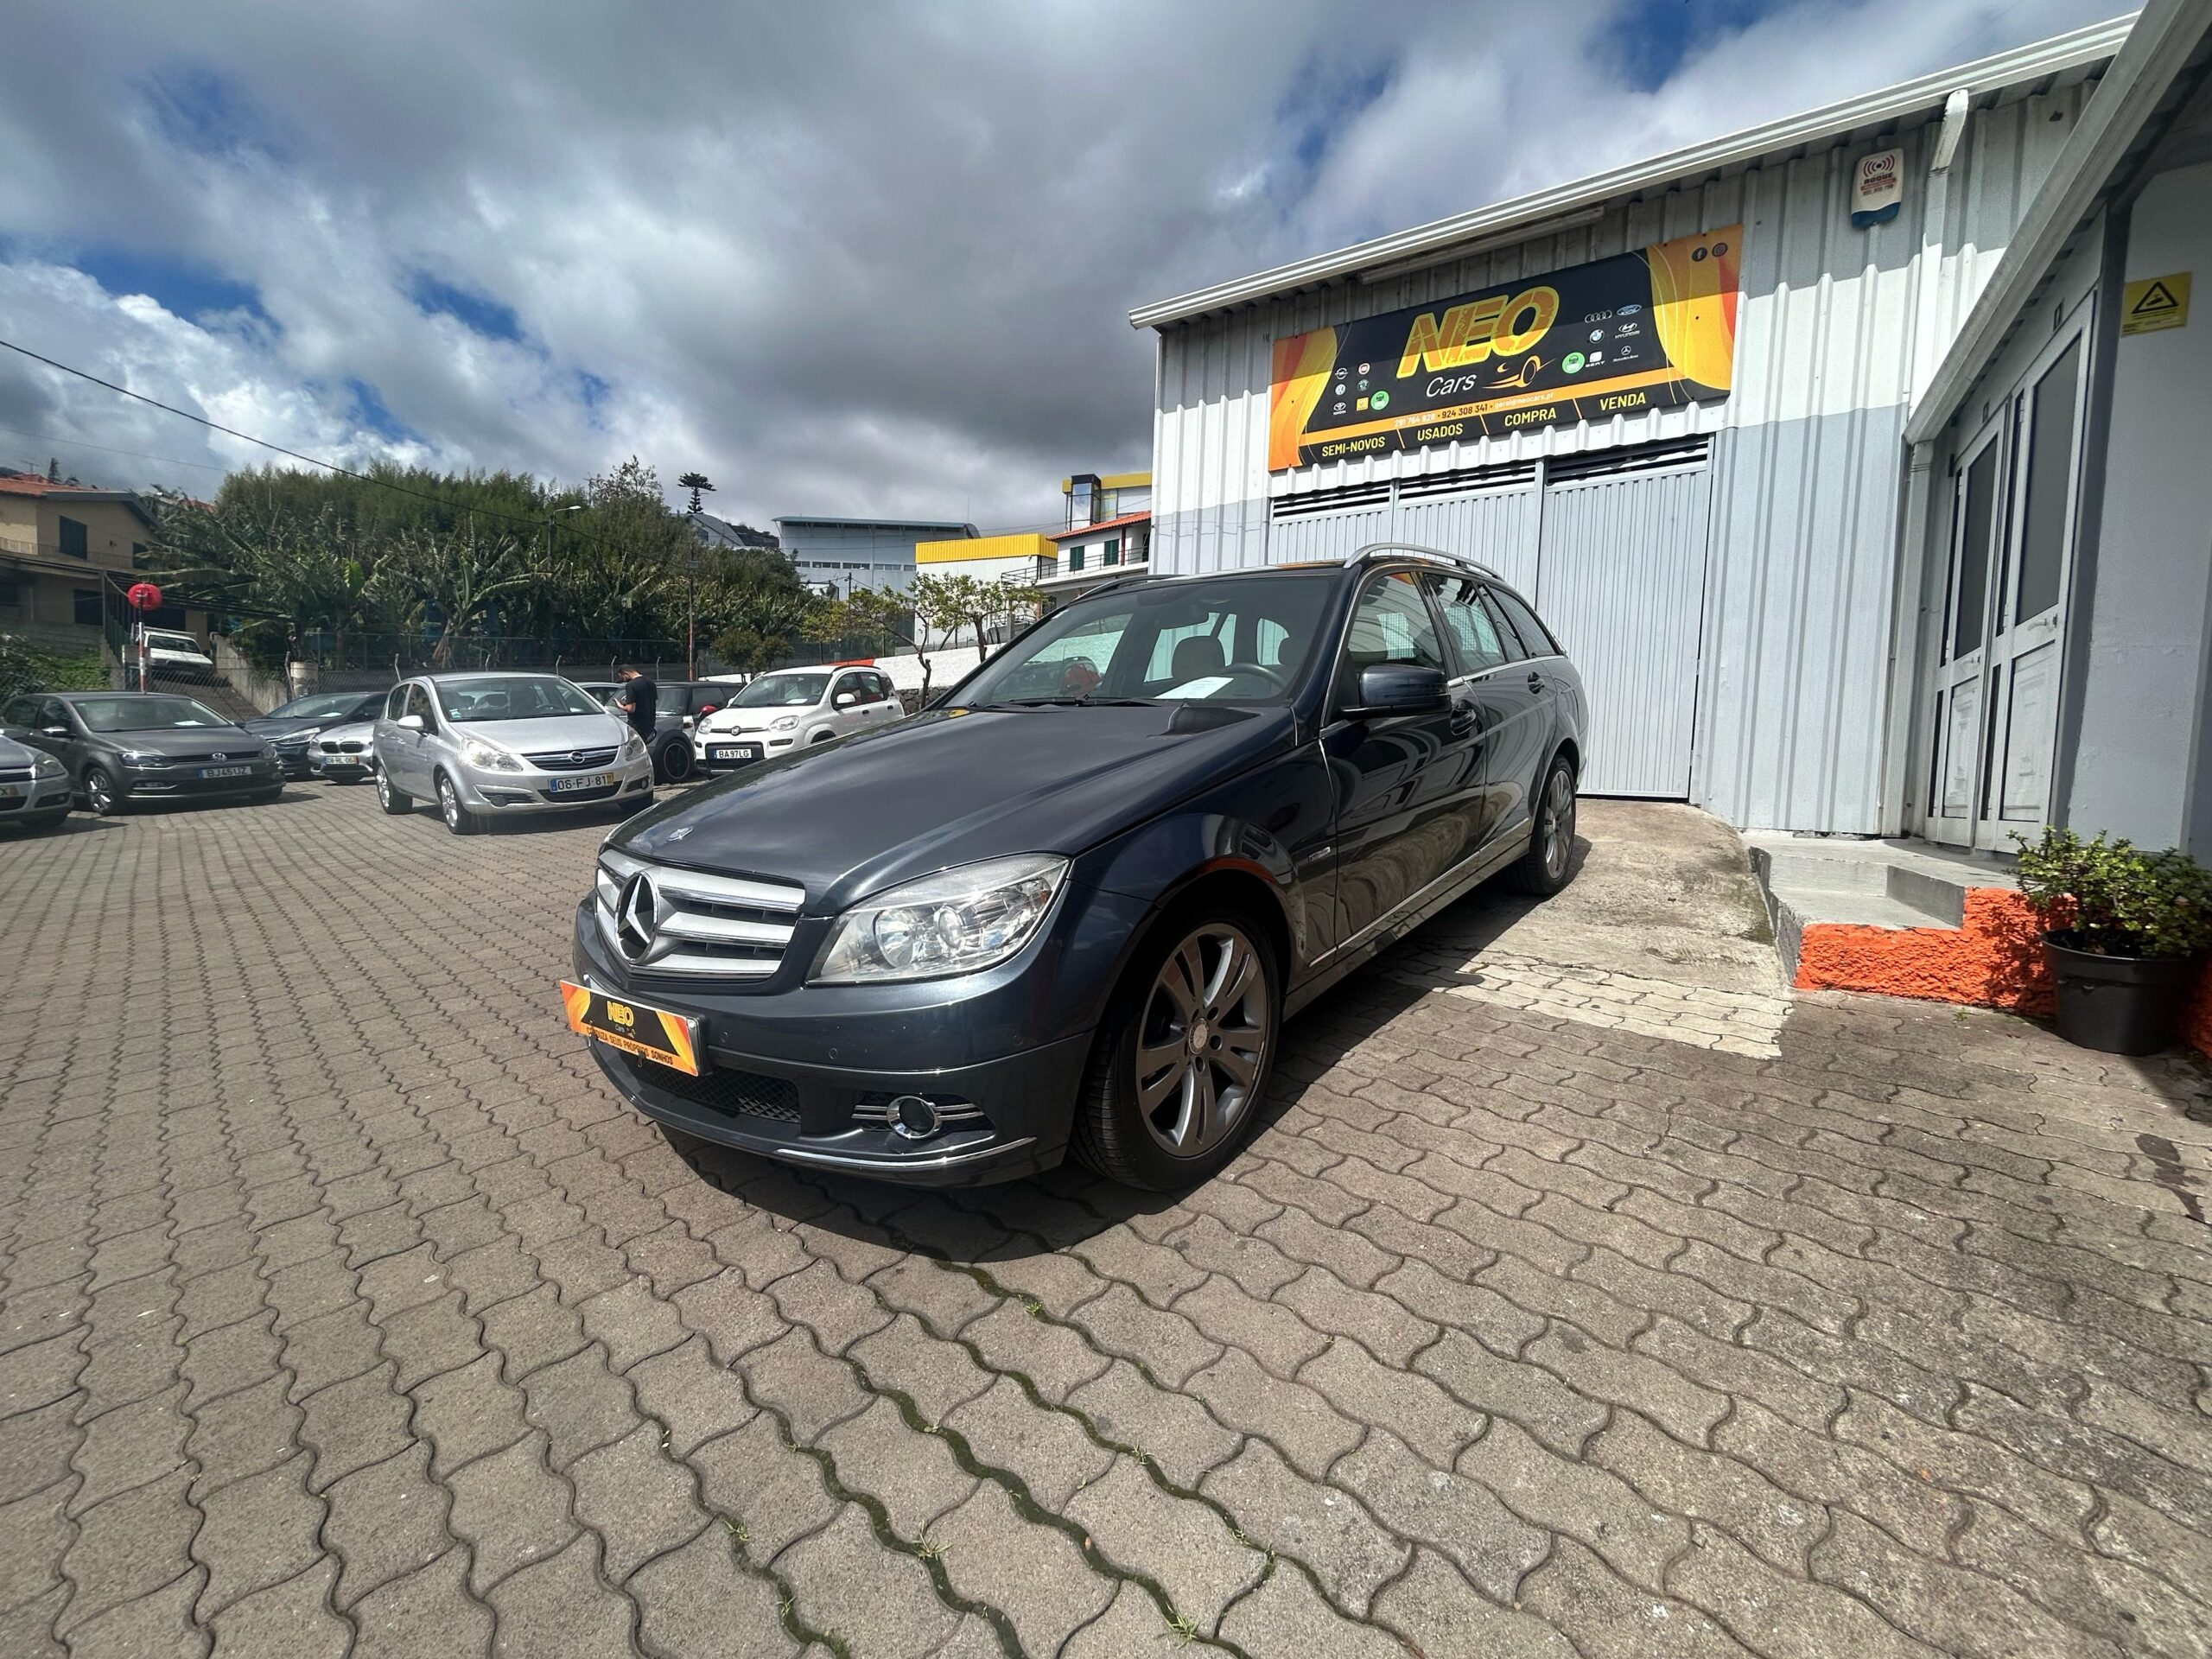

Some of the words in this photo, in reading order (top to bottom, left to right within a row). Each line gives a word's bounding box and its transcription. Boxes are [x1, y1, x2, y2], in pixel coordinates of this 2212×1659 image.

[1396, 286, 1560, 378] NEO
[1426, 374, 1478, 397] Cars
[1599, 391, 1647, 411] VENDA
[1441, 410, 1456, 419] 924
[1459, 406, 1473, 416] 308
[1475, 404, 1488, 413] 341
[1504, 407, 1557, 427] COMPRA
[1417, 423, 1464, 442] USADOS
[1322, 436, 1386, 457] SEMI-NOVOS
[607, 1001, 634, 1027] NEO
[651, 1050, 673, 1065] SONHOS
